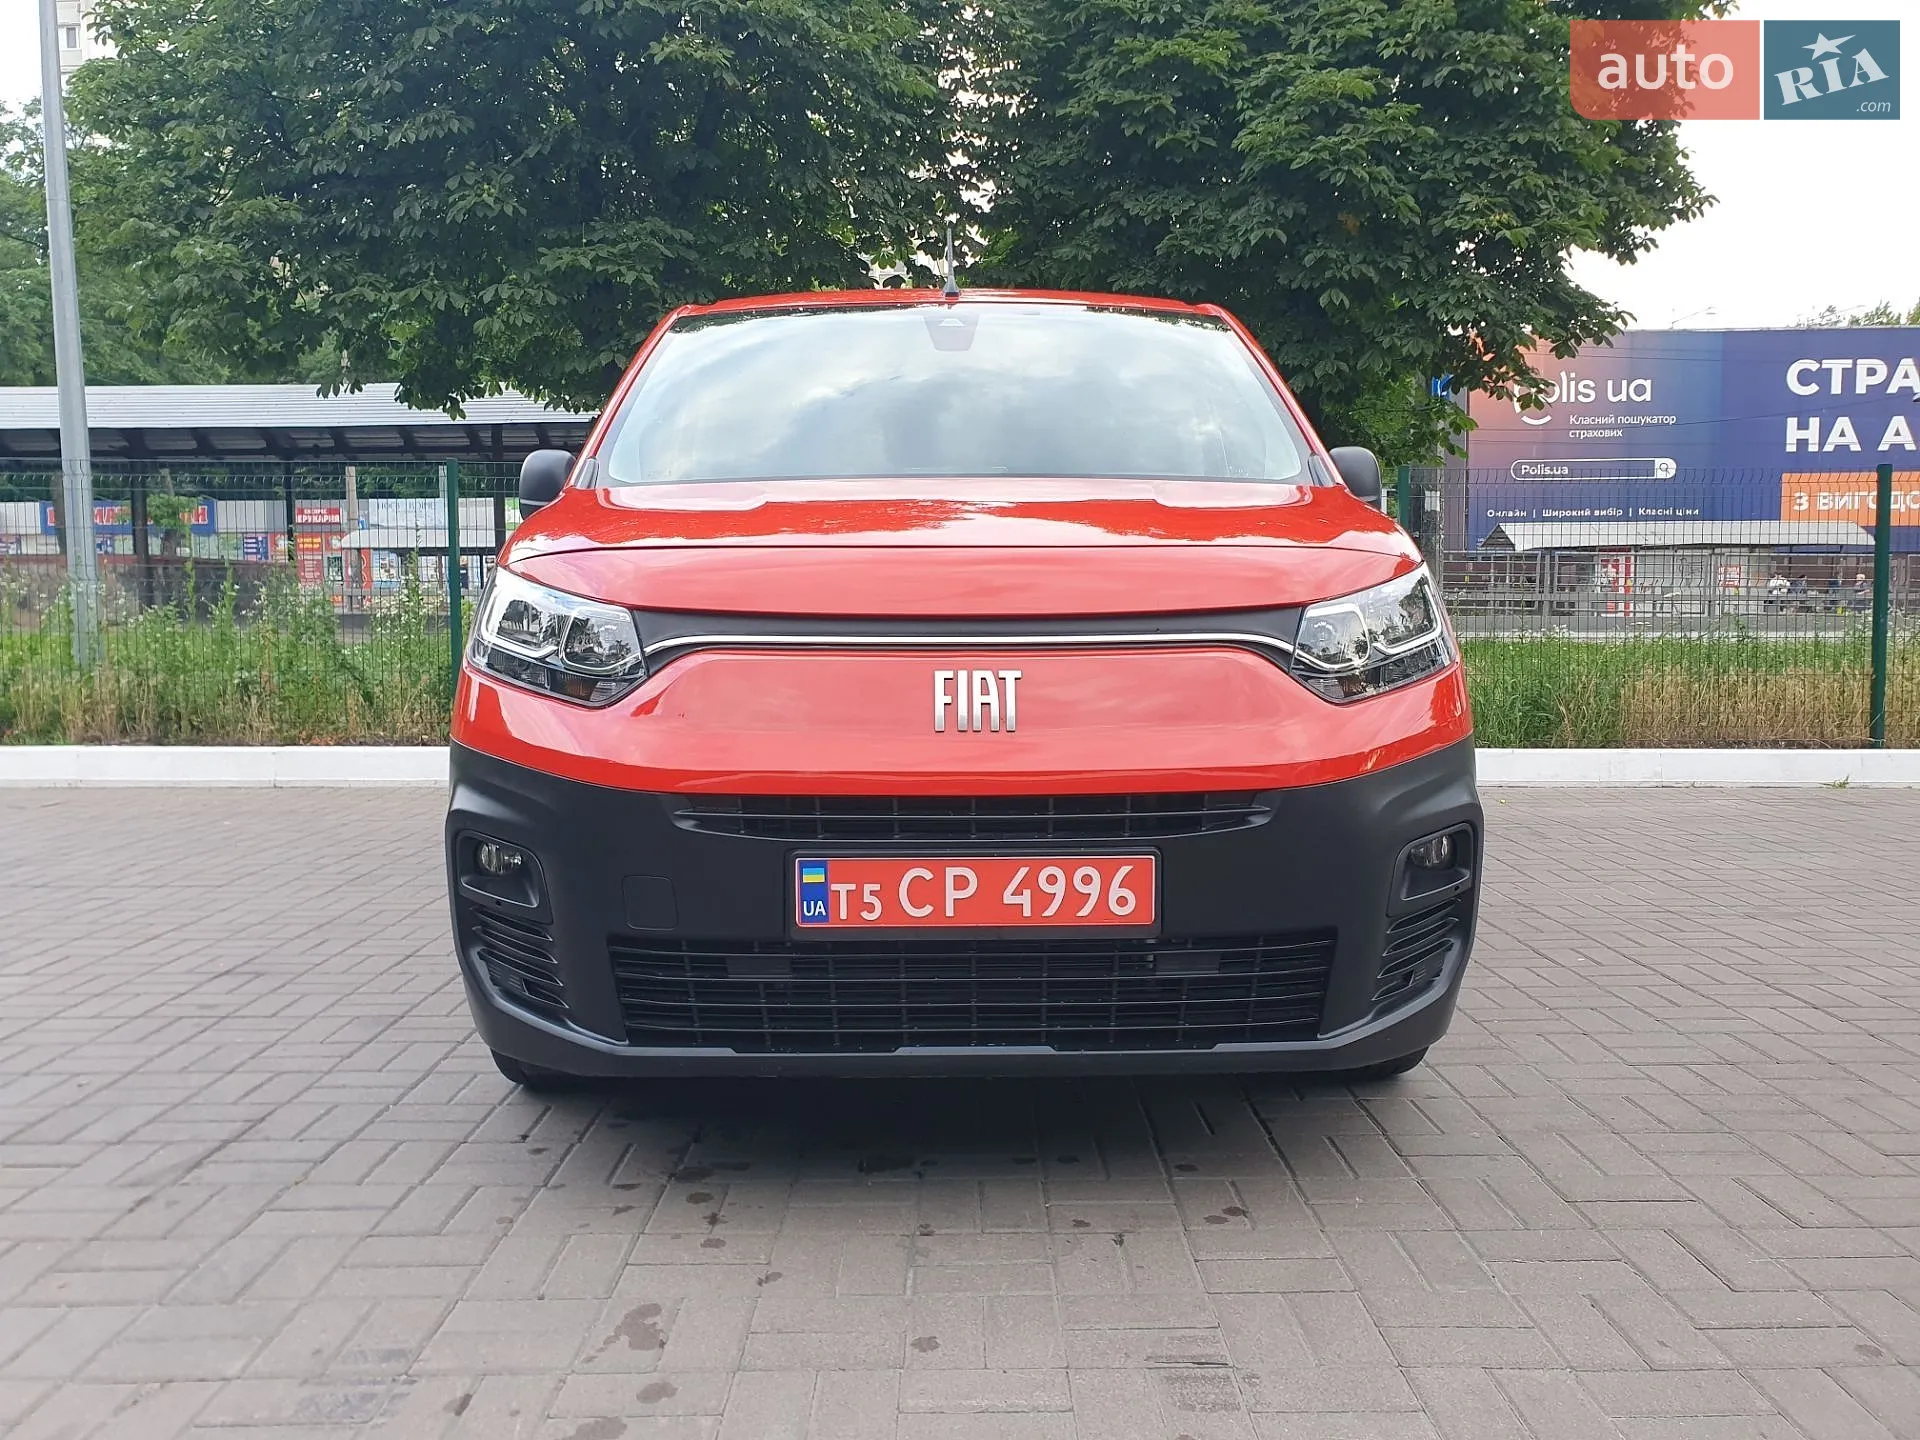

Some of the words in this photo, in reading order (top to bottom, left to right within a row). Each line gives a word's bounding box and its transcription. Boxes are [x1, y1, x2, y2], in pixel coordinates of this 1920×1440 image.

[1607, 378, 1652, 403] ua
[1569, 414, 1616, 425] Класний
[1618, 415, 1677, 427] пошукатор
[1569, 429, 1623, 440] страхових
[1785, 416, 1862, 453] НА
[1521, 464, 1569, 475] Polis.ua
[1487, 508, 1527, 518] Онлайн
[1542, 508, 1591, 518] Широкий
[1594, 507, 1623, 518] вибір
[1638, 507, 1673, 516] Класні
[933, 669, 1023, 732] FIAT
[803, 900, 826, 916] UA
[830, 883, 882, 920] T5
[898, 866, 978, 917] CP
[1002, 865, 1137, 917] 4996
